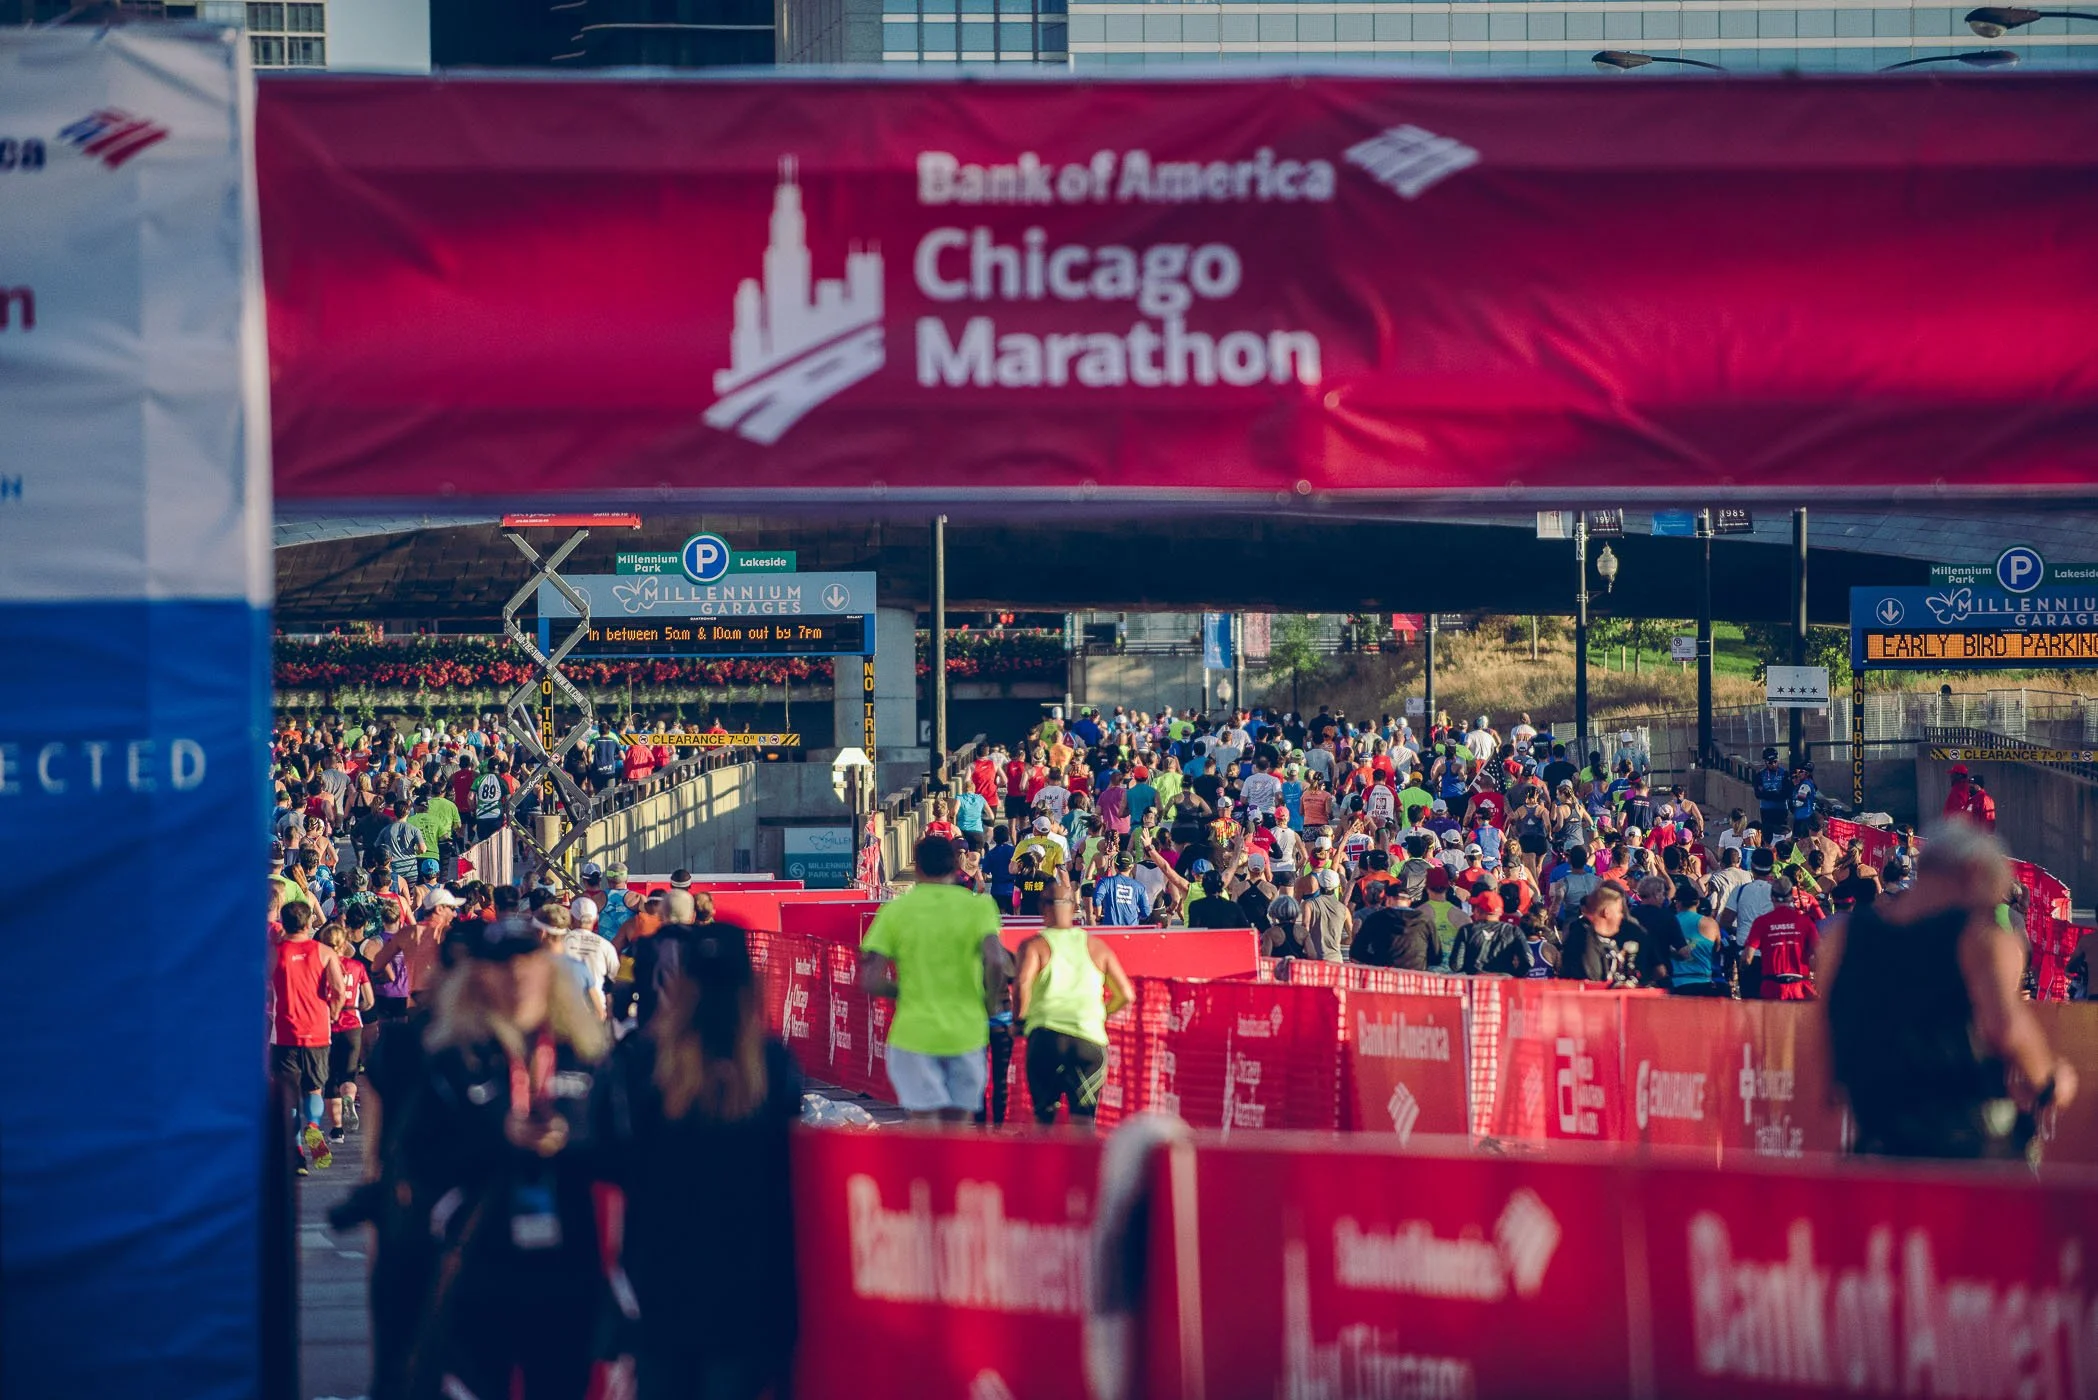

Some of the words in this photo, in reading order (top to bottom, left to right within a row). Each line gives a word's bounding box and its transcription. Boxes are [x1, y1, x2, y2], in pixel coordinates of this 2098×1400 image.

[917, 150, 1053, 205] Bank
[1055, 149, 1116, 203] of
[1118, 146, 1337, 202] America
[913, 226, 1243, 318] Chicago
[914, 311, 1323, 388] Marathon
[618, 554, 678, 564] Millennium
[696, 543, 719, 574] P
[739, 557, 787, 567] Lakeside
[634, 563, 662, 573] Park
[1931, 566, 1992, 575] Millennium
[2010, 555, 2033, 585] P
[1948, 574, 1975, 584] Park
[644, 585, 801, 601] MILLENNIUM
[701, 601, 801, 615] GARAGES
[1958, 597, 2097, 612] MILLENNIU
[606, 627, 659, 641] between
[665, 626, 691, 641] 5am
[697, 626, 707, 640] &
[713, 626, 742, 640] 10am
[748, 625, 770, 640] out
[775, 625, 792, 640] by
[1883, 634, 1948, 658] EARLY
[1963, 634, 2008, 658] BIRD
[864, 662, 874, 691] NO
[1853, 676, 1863, 705] NO
[652, 734, 725, 745] CLEARANCE
[864, 703, 875, 761] TRUC
[1853, 717, 1863, 804] TRUCKS
[1963, 750, 2038, 760] CLEARANCE
[0, 738, 207, 796] ECTED
[482, 784, 497, 799] 89
